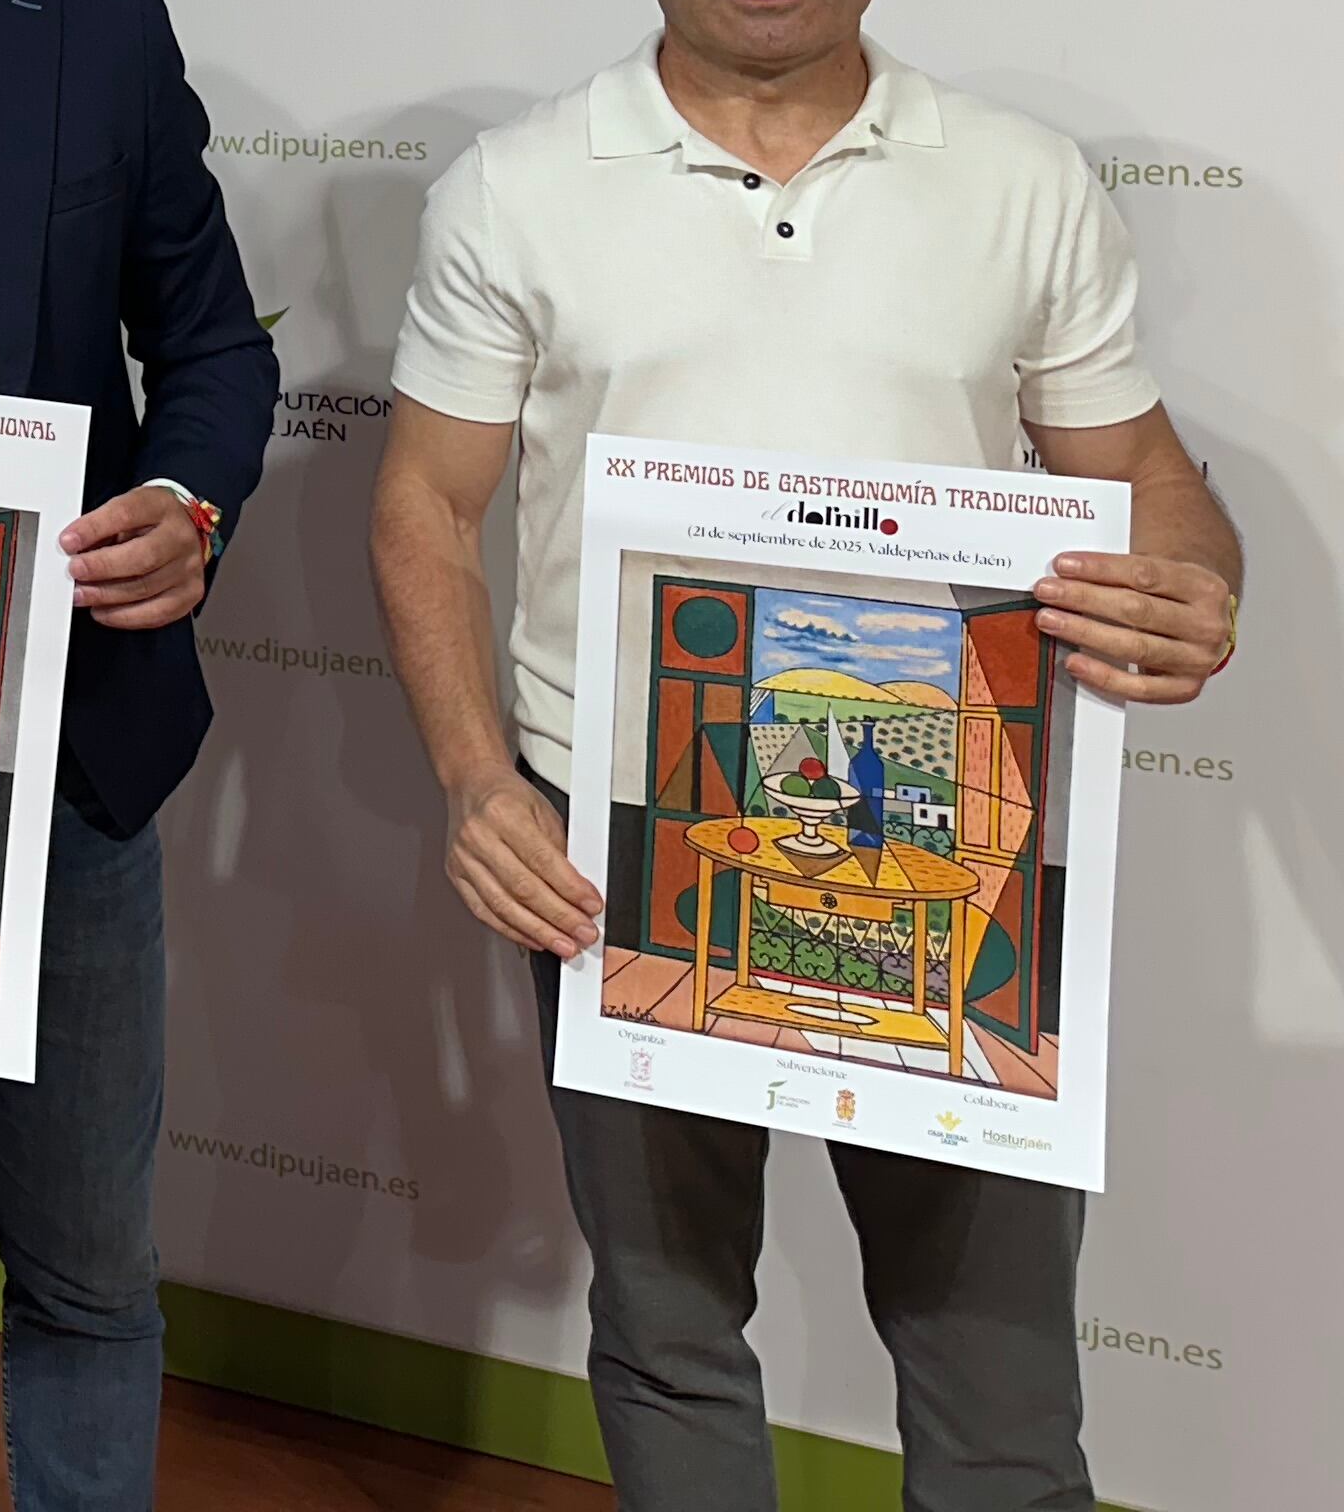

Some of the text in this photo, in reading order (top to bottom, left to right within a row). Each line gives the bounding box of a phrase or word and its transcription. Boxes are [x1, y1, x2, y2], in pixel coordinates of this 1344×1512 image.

[281, 419, 346, 442] JAÉN
[606, 457, 1095, 520] XX PREMIOS DE GASTRONOMÍA TRADICIONAL
[708, 526, 725, 540] de
[728, 529, 806, 551] septiembre
[808, 536, 826, 550] de
[869, 540, 950, 563] Valdepeñas
[953, 549, 970, 563] de
[971, 551, 1012, 569] Jaén)
[168, 1129, 420, 1200] www.dipujaen.es
